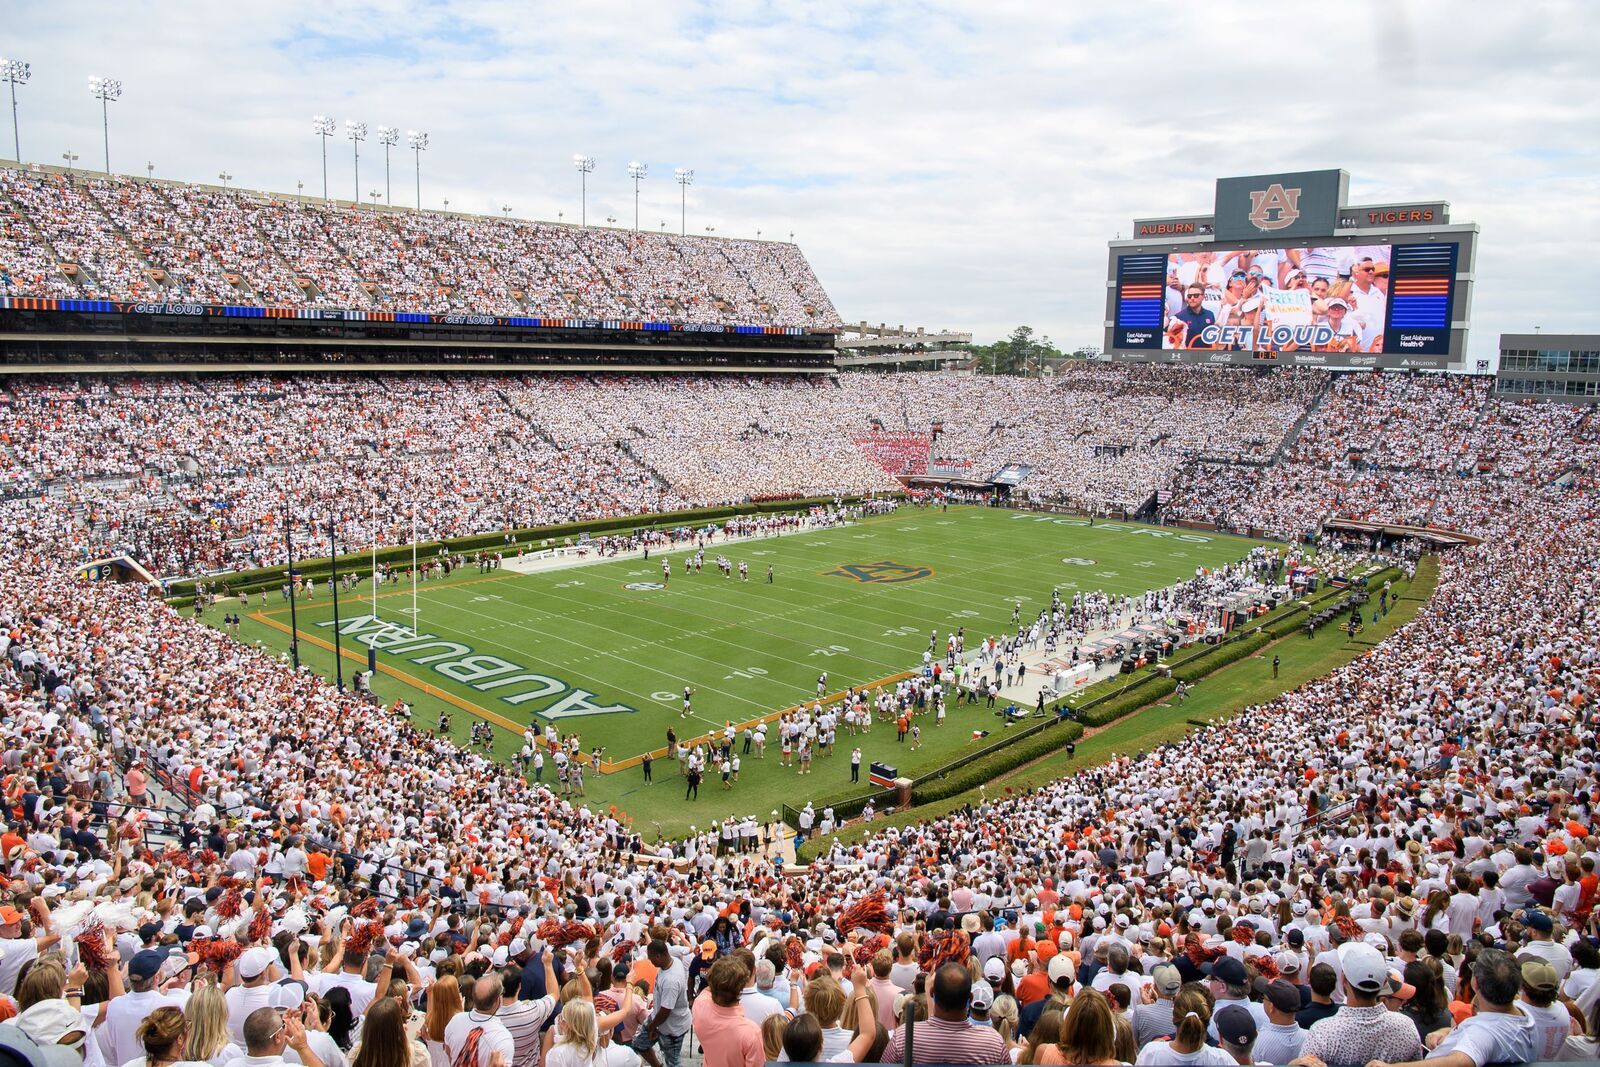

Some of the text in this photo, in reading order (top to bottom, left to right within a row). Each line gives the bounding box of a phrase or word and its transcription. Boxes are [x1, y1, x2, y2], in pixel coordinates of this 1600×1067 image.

[1368, 209, 1434, 224] TIGERS
[1140, 222, 1195, 235] AUBURN
[135, 302, 204, 316] GET LOUD
[445, 315, 495, 325] GET LOUD
[683, 324, 724, 333] GET LOUD
[1201, 325, 1333, 347] GET LOUD
[1478, 360, 1488, 368] 25
[1010, 513, 1216, 543] TIGERS
[818, 645, 850, 657] 20
[313, 614, 640, 721] AUBURN
[733, 667, 769, 679] 10
[650, 691, 681, 702] G
[1505, 829, 1521, 840] 27
[1296, 848, 1309, 859] 34
